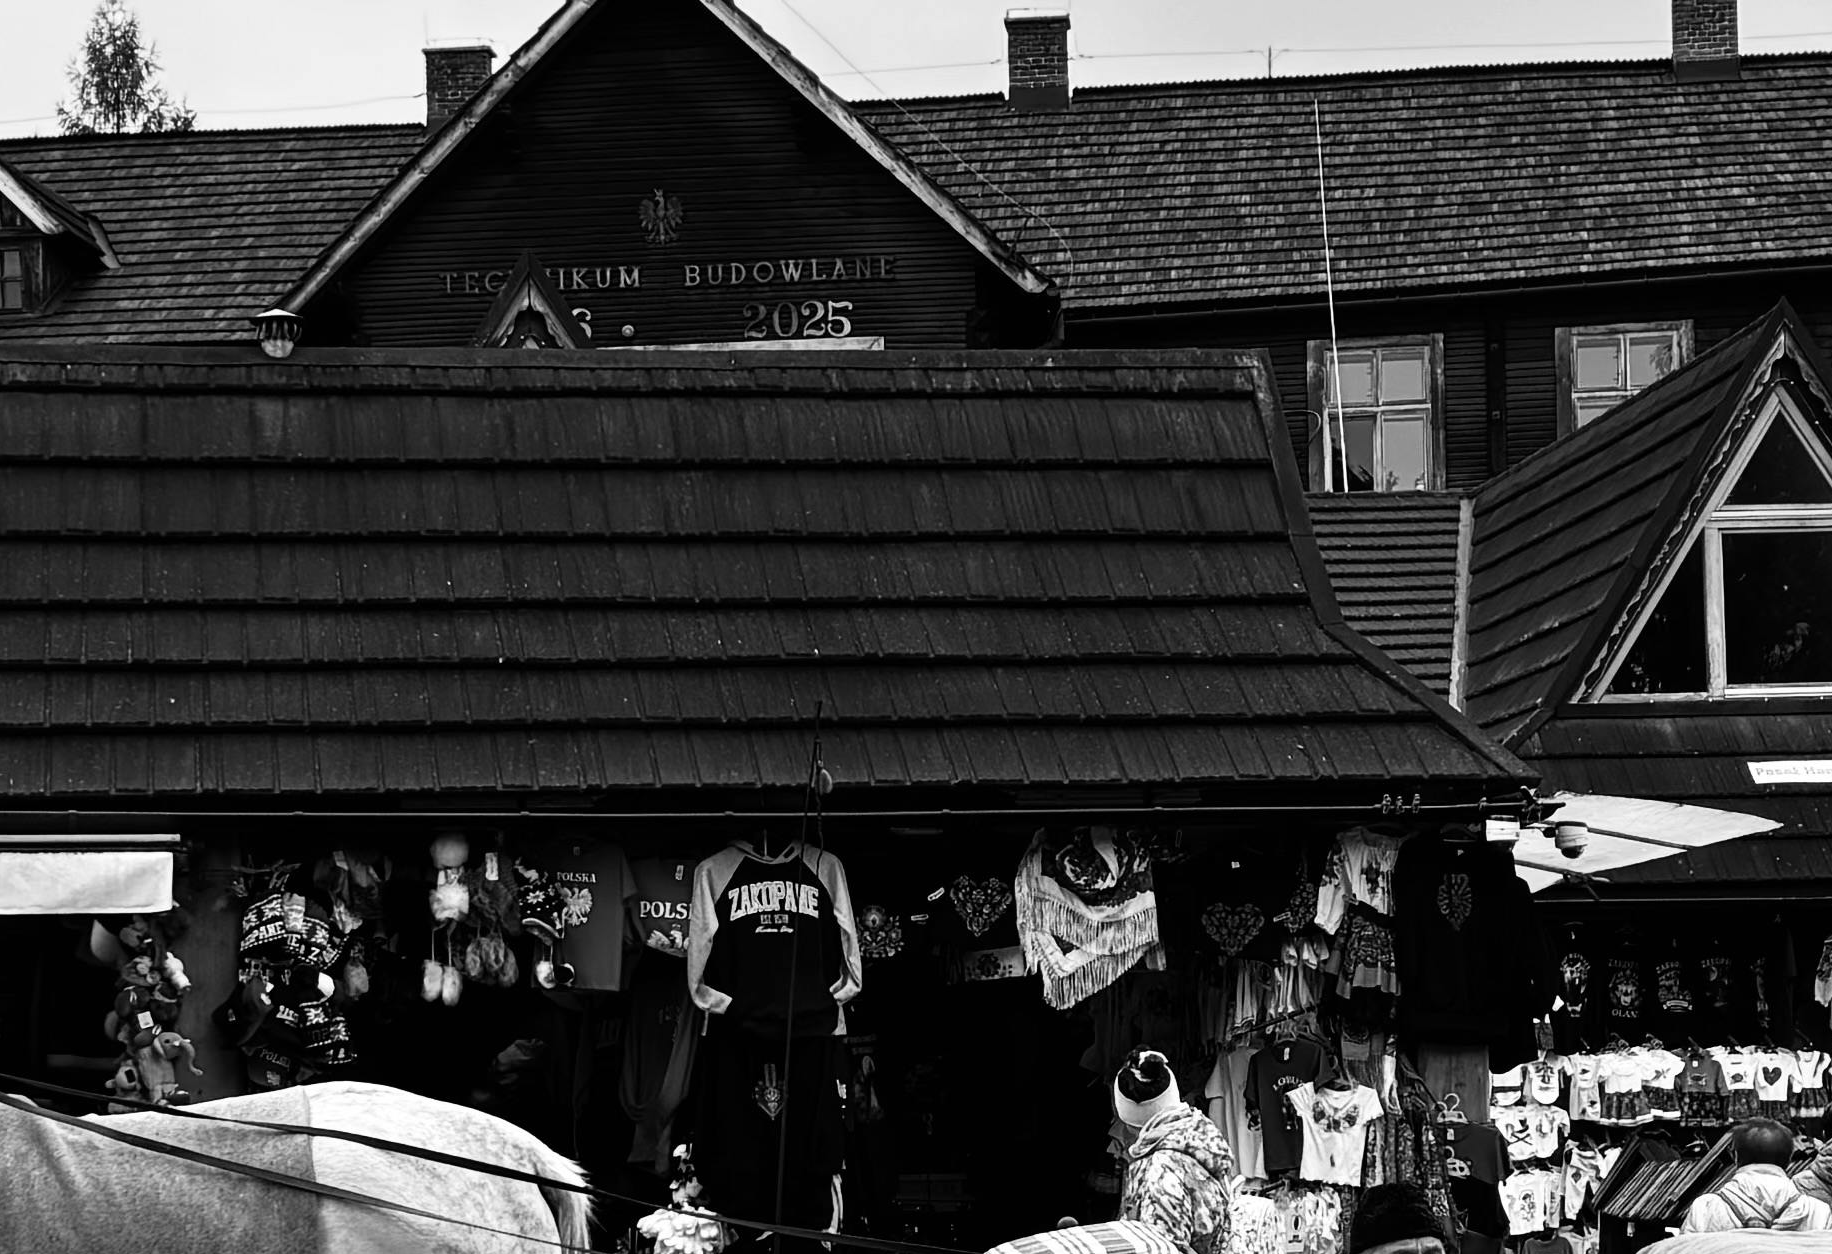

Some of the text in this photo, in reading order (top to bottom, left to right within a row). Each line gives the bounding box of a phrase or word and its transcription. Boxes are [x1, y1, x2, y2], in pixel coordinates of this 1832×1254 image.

[439, 256, 895, 294] TECIKUM BUDOWLANE
[743, 300, 853, 338] 2025
[556, 871, 597, 884] POLSKA
[639, 900, 692, 921] POLS
